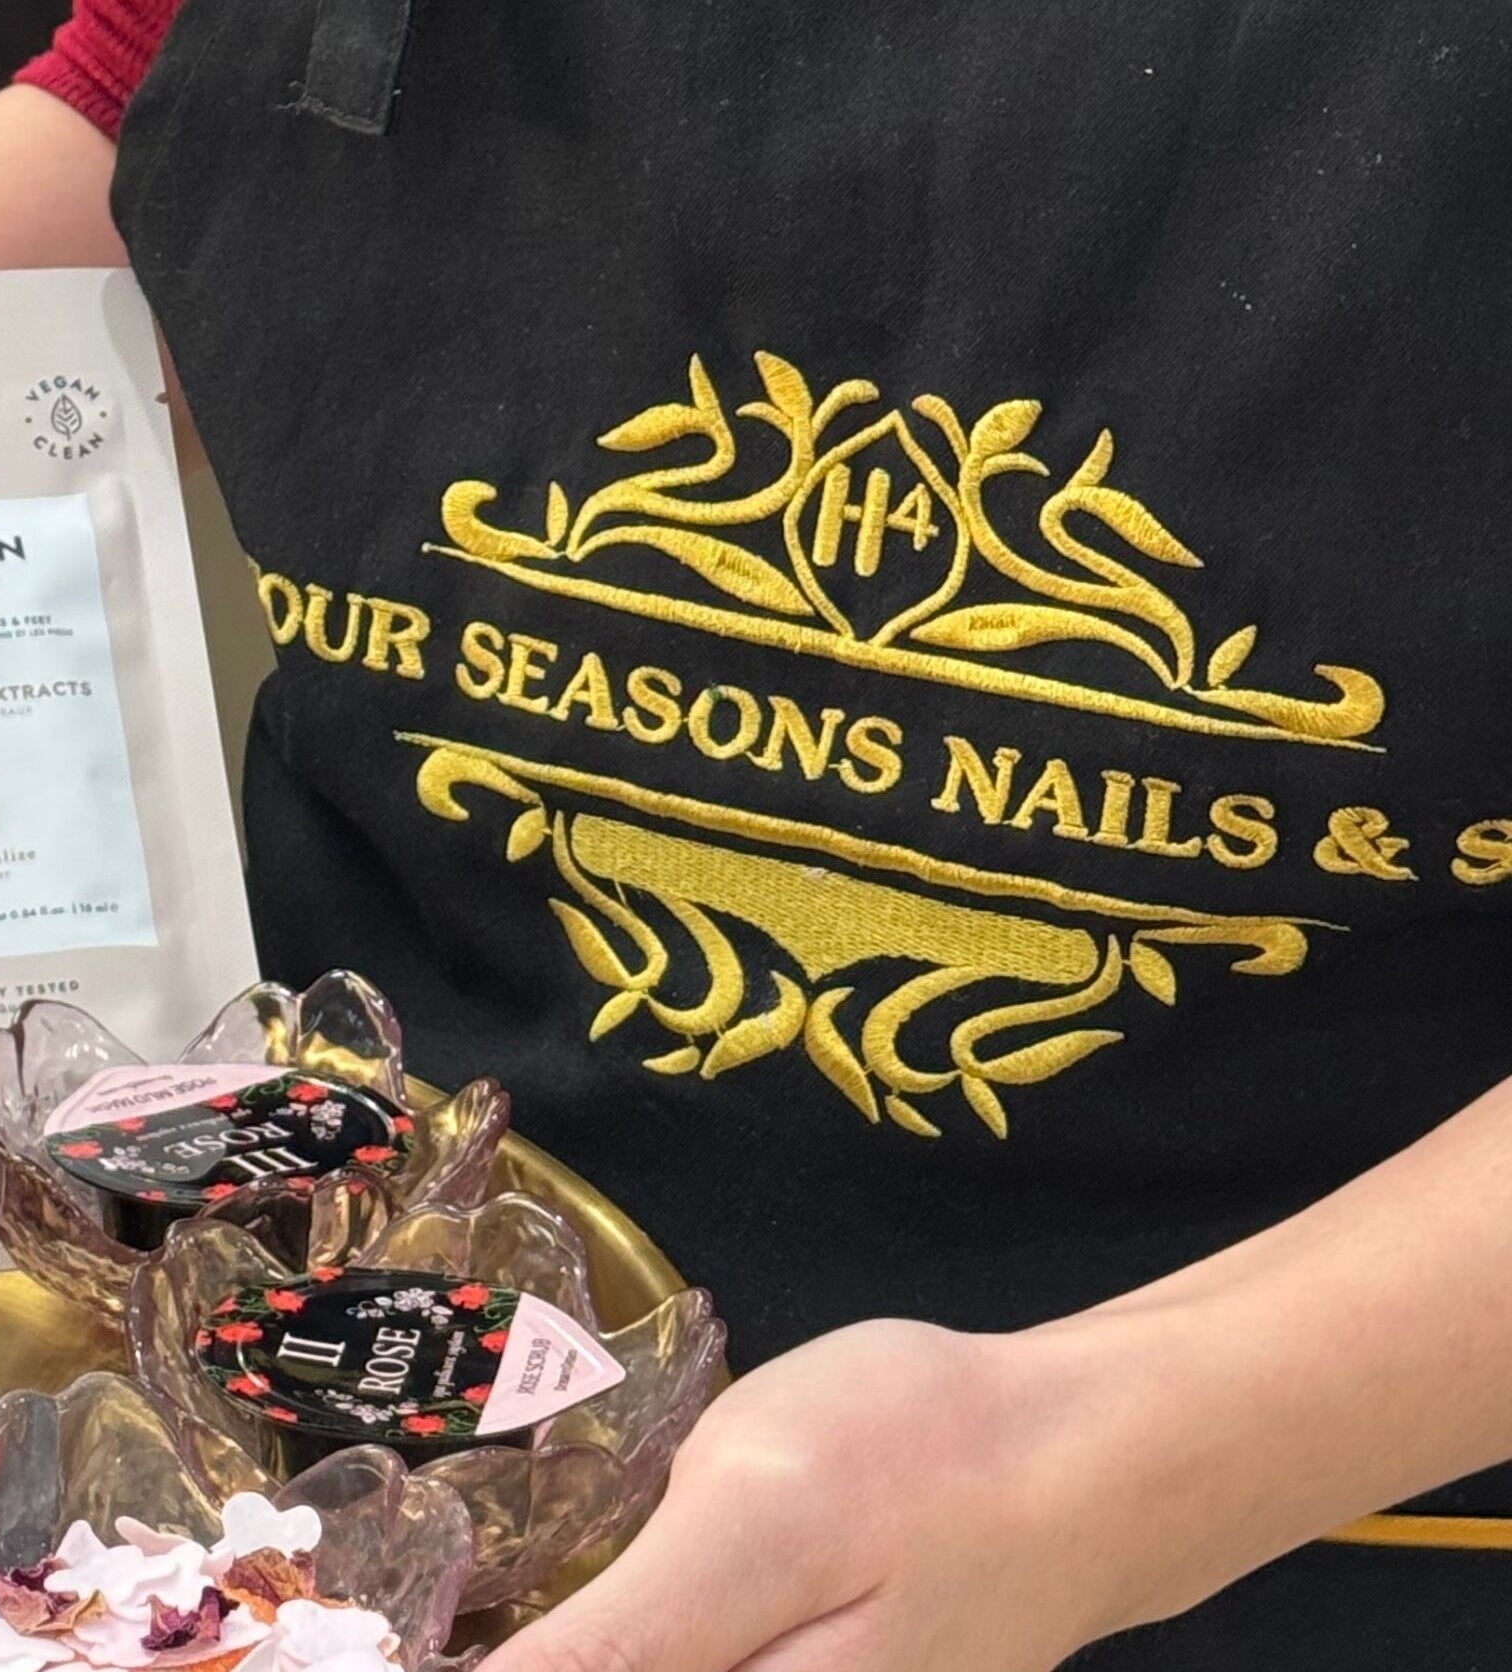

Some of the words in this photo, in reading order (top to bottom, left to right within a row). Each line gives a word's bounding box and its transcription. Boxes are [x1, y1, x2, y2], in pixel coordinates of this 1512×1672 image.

[25, 375, 100, 401] VEGAN
[33, 432, 104, 460] CLEAN
[812, 462, 938, 578] H4
[11, 615, 21, 627] &
[24, 614, 53, 626] FEET
[249, 558, 431, 680] OUR
[455, 620, 905, 798] SEASONS
[932, 735, 1276, 871] NAILS
[1313, 806, 1419, 881] &
[16, 979, 80, 997] TESTED
[164, 1121, 295, 1159] ROSE
[219, 1146, 320, 1180] III
[276, 1331, 346, 1367] II
[356, 1327, 421, 1395] ROSE
[516, 1372, 537, 1394] ROSE
